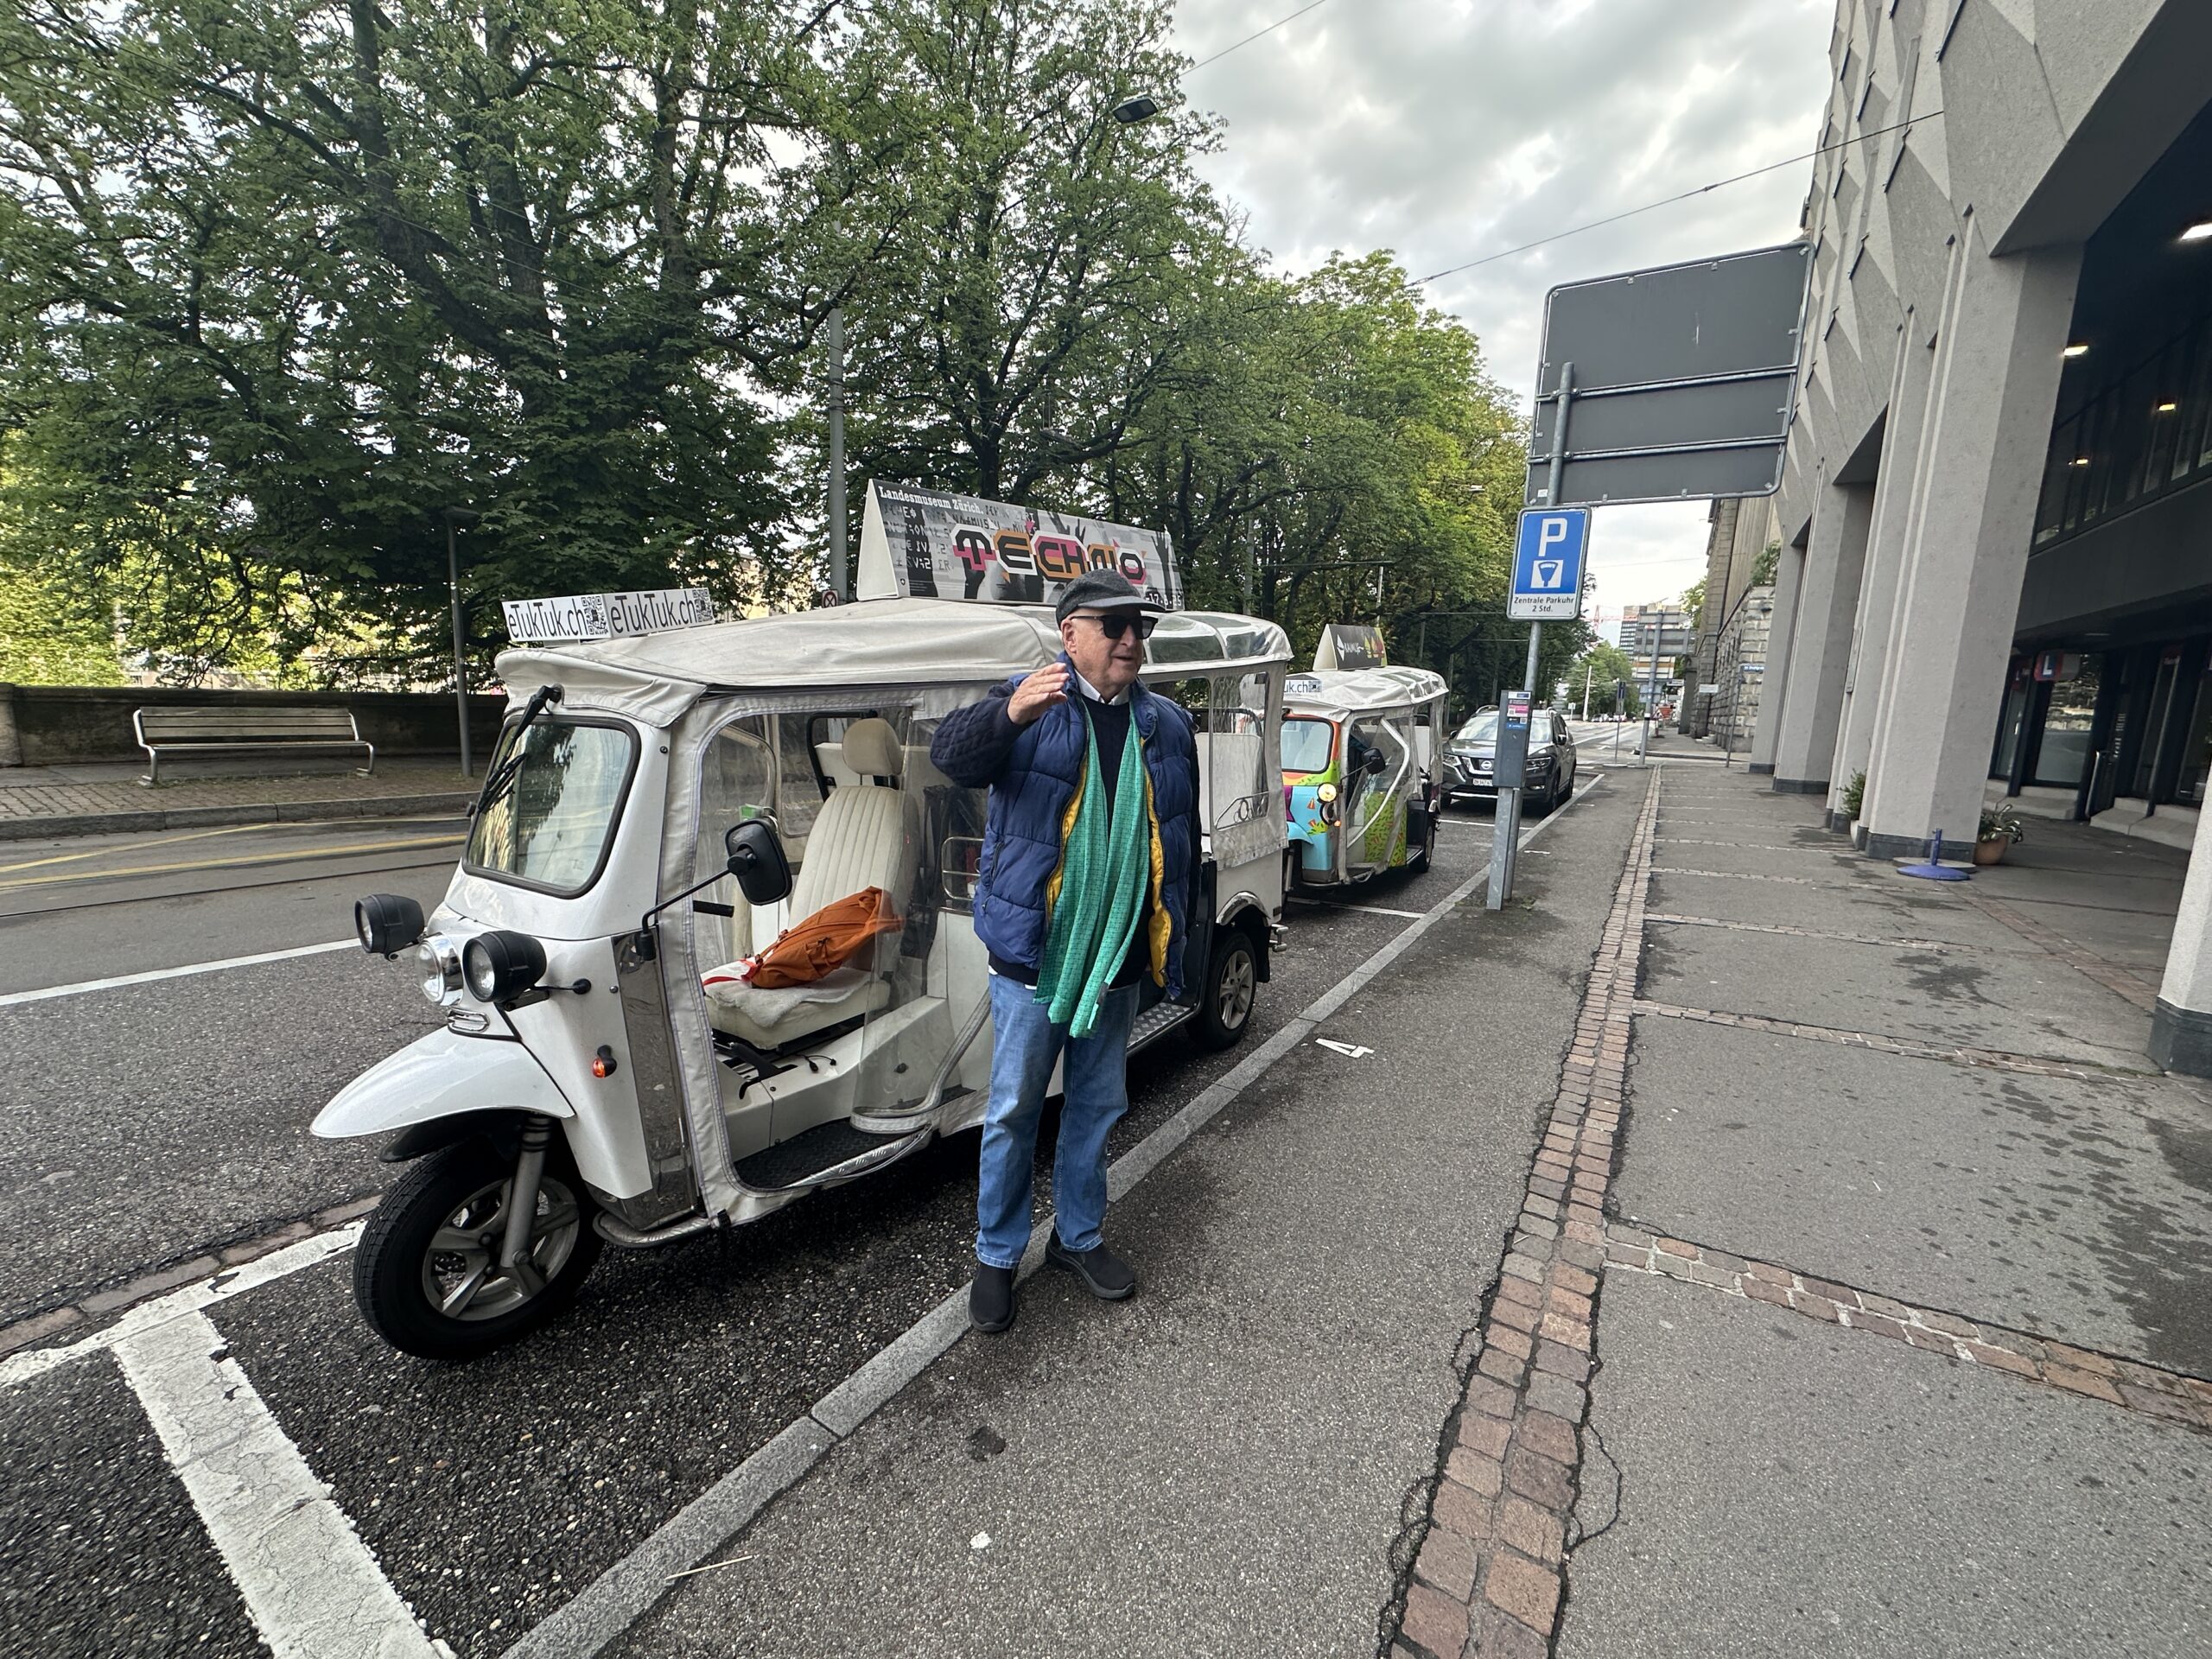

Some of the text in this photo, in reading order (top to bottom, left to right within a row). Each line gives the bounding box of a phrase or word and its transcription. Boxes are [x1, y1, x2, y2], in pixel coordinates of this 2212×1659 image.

[878, 486, 951, 509] Landesmuseum
[952, 498, 984, 514] Zürich.
[952, 526, 1146, 584] TECHNO
[1538, 518, 1567, 557] P
[507, 598, 588, 639] eTukTuk.ch
[610, 589, 698, 634] eTukTuk.ch
